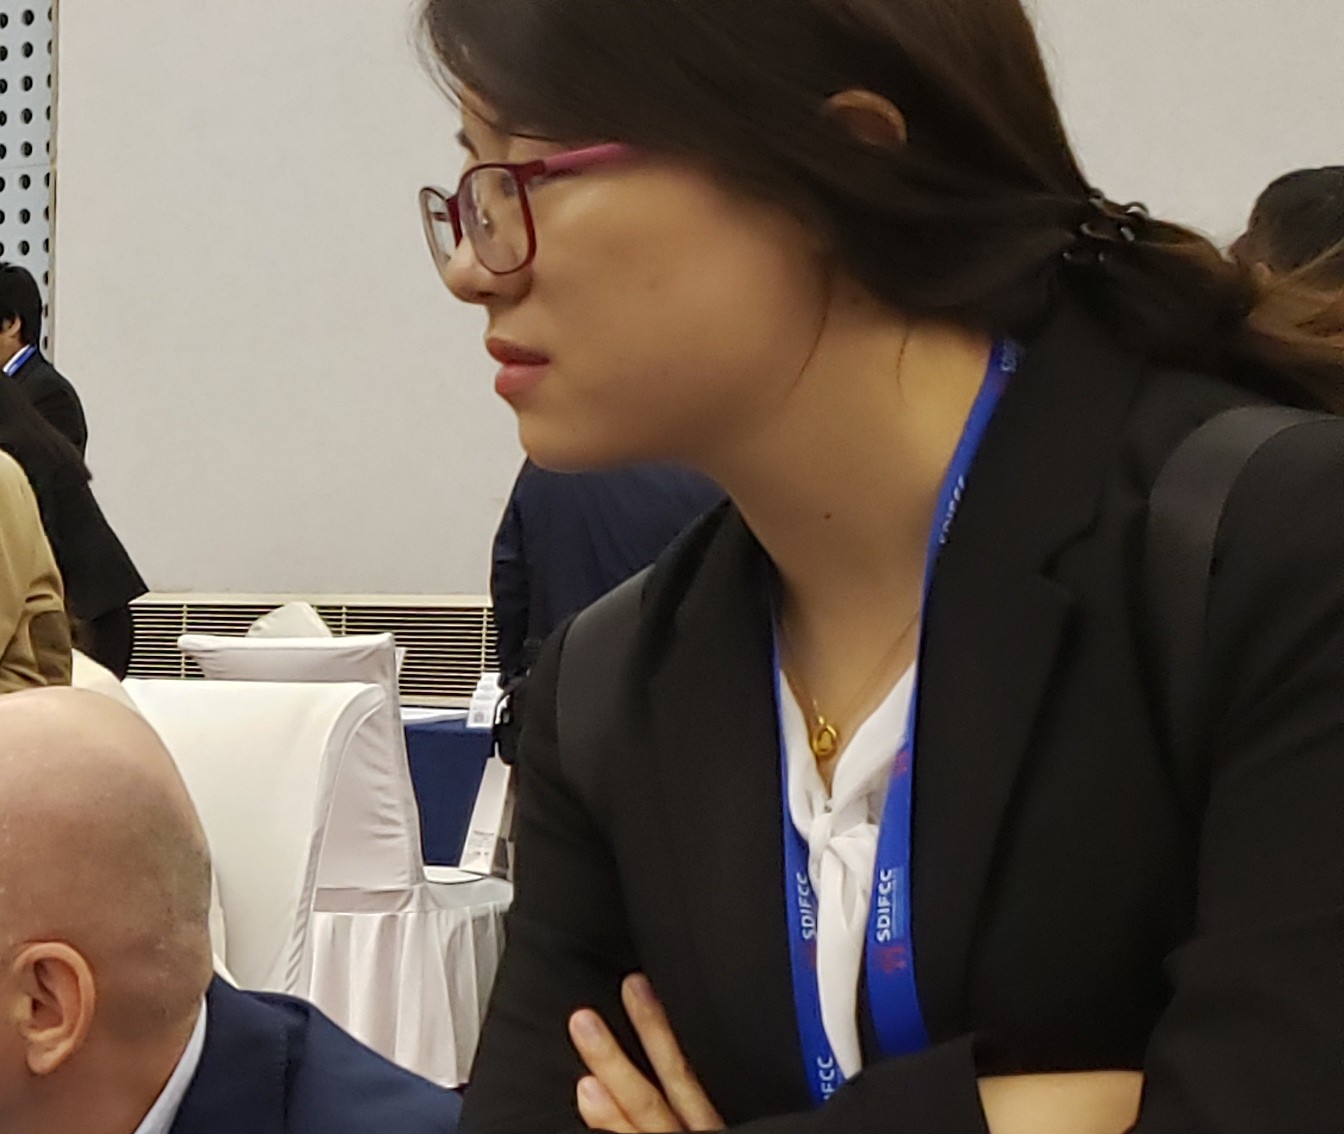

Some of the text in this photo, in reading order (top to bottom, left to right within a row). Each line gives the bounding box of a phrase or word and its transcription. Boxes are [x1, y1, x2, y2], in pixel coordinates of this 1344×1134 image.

[796, 871, 817, 940] SDIFCC
[876, 868, 893, 943] SDIFCC
[817, 1056, 835, 1100] FCC
